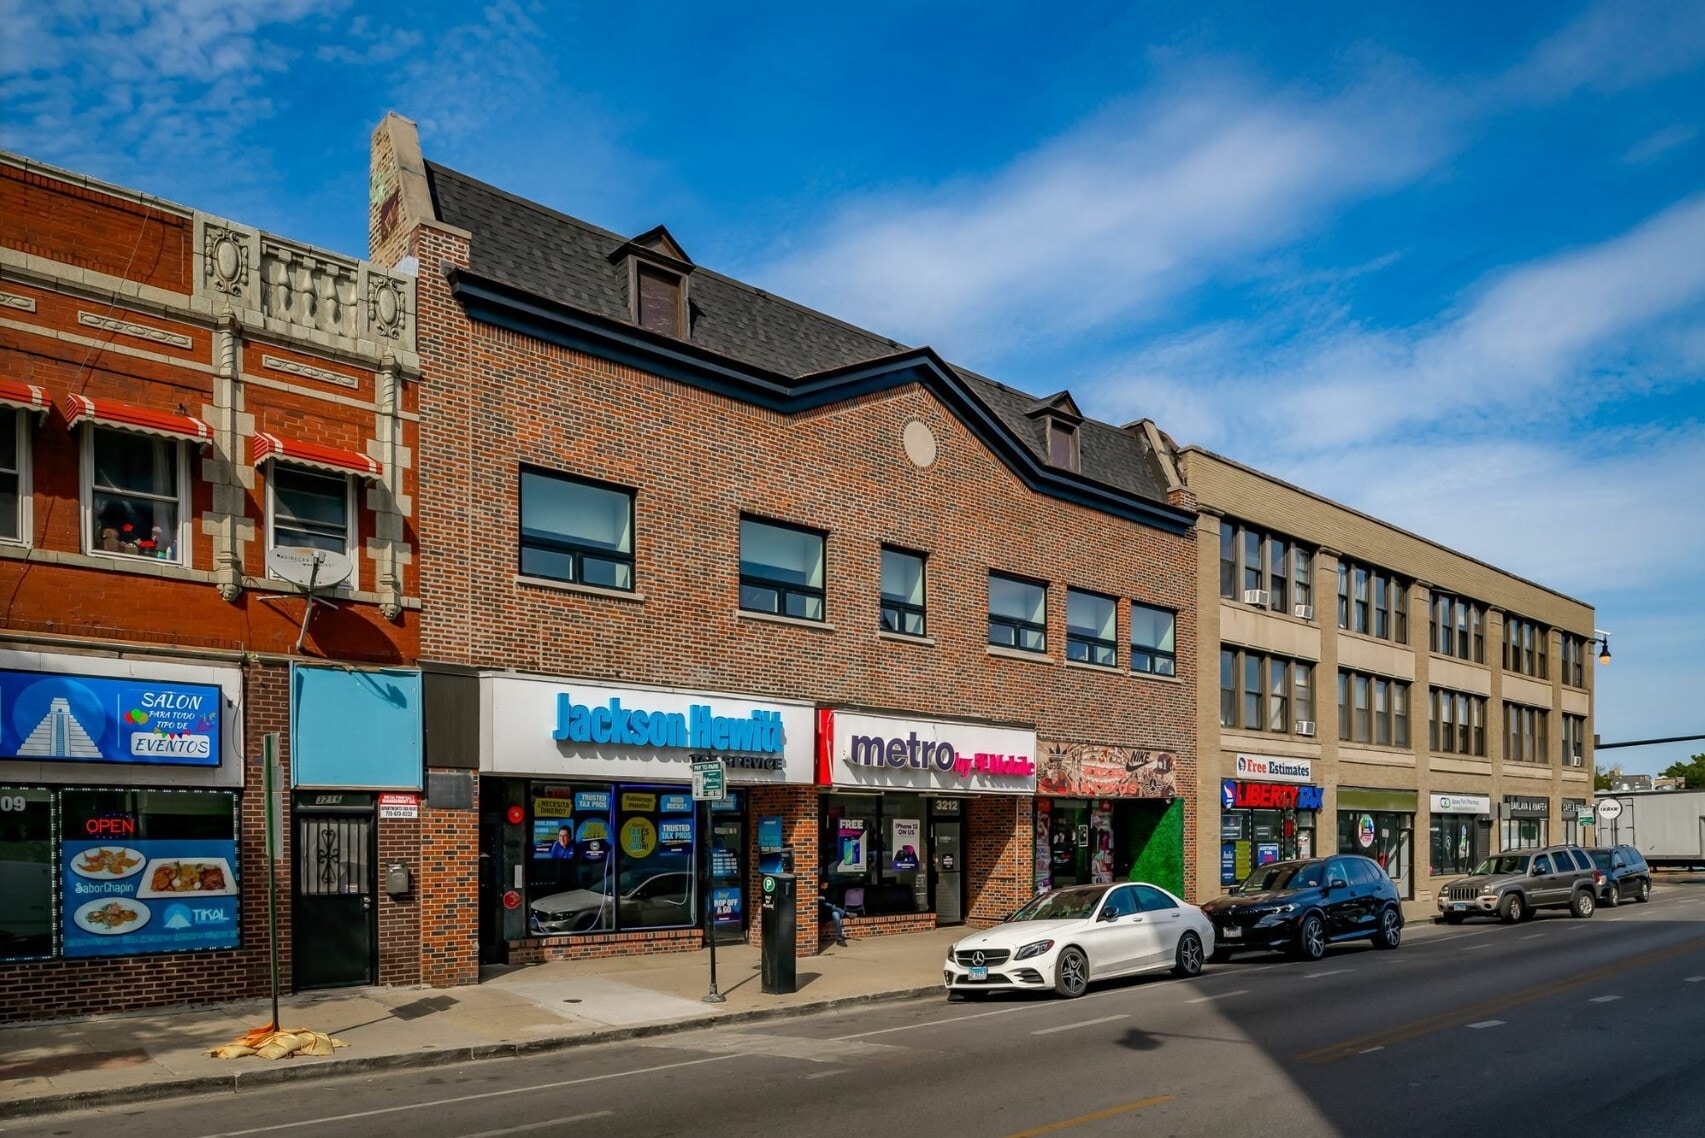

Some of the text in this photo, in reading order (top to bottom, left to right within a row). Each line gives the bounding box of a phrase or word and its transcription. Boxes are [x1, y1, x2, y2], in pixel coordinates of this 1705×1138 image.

[141, 692, 203, 710] SALON
[148, 710, 196, 720] PARA TODO
[156, 720, 188, 730] TIPO DE
[552, 692, 784, 753] Jackson Hewitt
[135, 738, 209, 754] EVENTOS
[851, 731, 956, 771] metro
[955, 752, 973, 778] by
[1130, 750, 1151, 763] NIKE
[724, 755, 785, 770] SERVICE
[1246, 759, 1310, 777] Free Estimates
[1235, 782, 1299, 808] LIBERTY
[591, 801, 607, 809] PROS
[936, 800, 958, 810] 3212
[86, 819, 135, 833] OPEN
[662, 824, 690, 832] TRUSTED
[840, 819, 864, 829] FREE
[661, 831, 692, 840] TAX PROS
[766, 879, 772, 889] P
[727, 898, 738, 906] OFF
[192, 908, 230, 921] TIKAL
